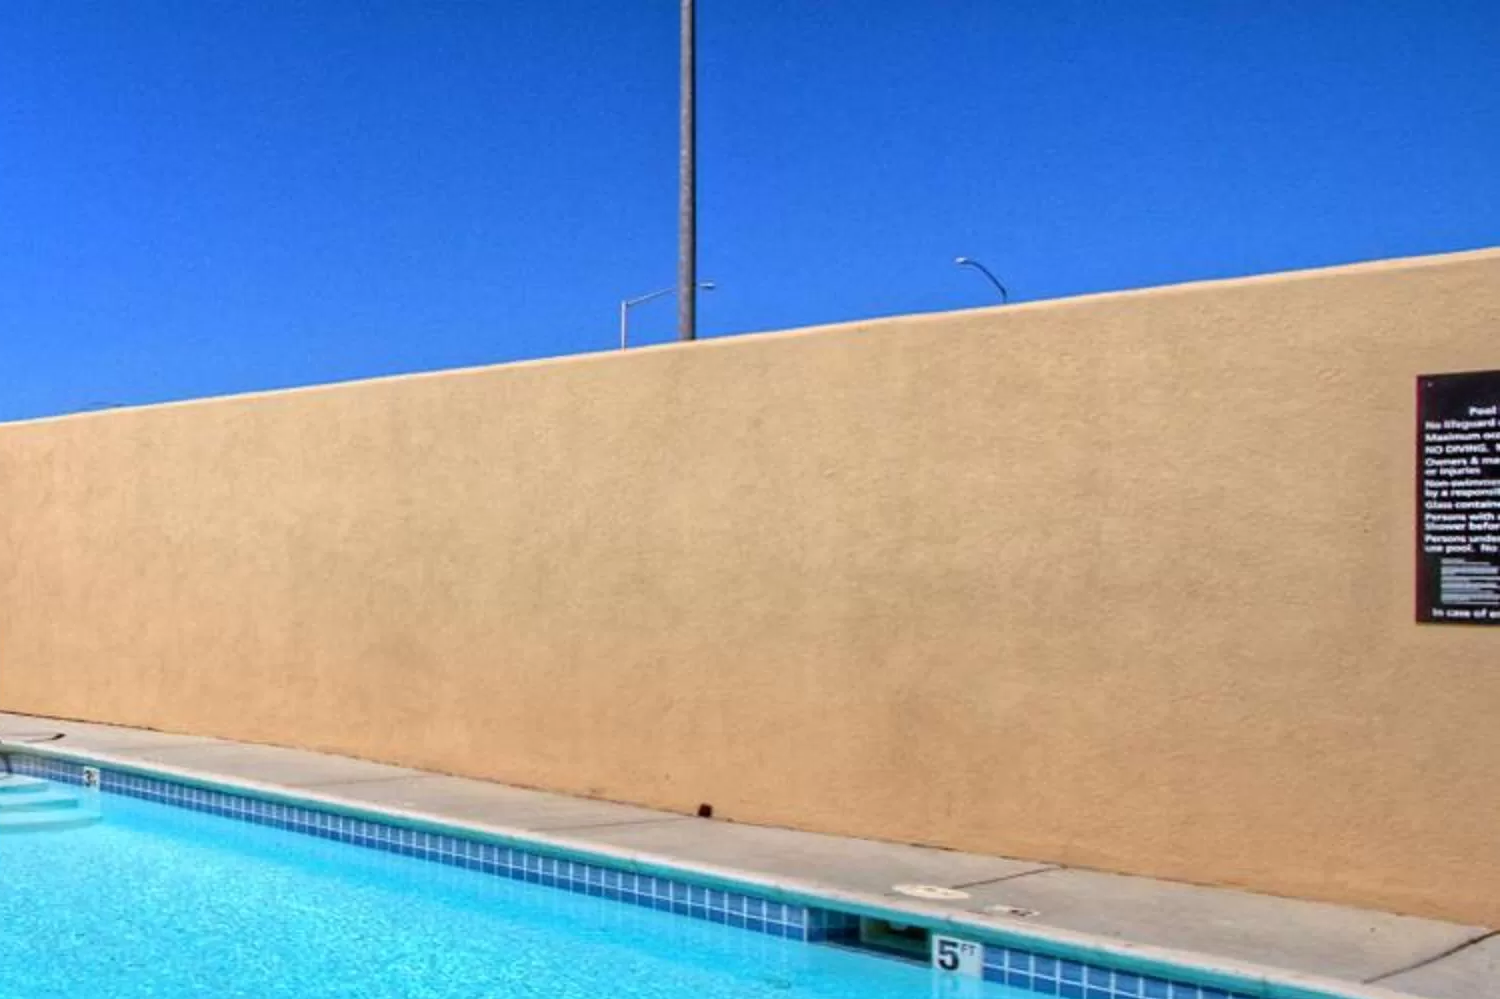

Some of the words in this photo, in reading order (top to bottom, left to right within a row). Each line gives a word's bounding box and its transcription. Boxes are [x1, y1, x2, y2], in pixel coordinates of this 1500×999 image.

[1469, 405, 1497, 417] Pool
[938, 939, 960, 970] 5
[961, 944, 977, 957] FT
